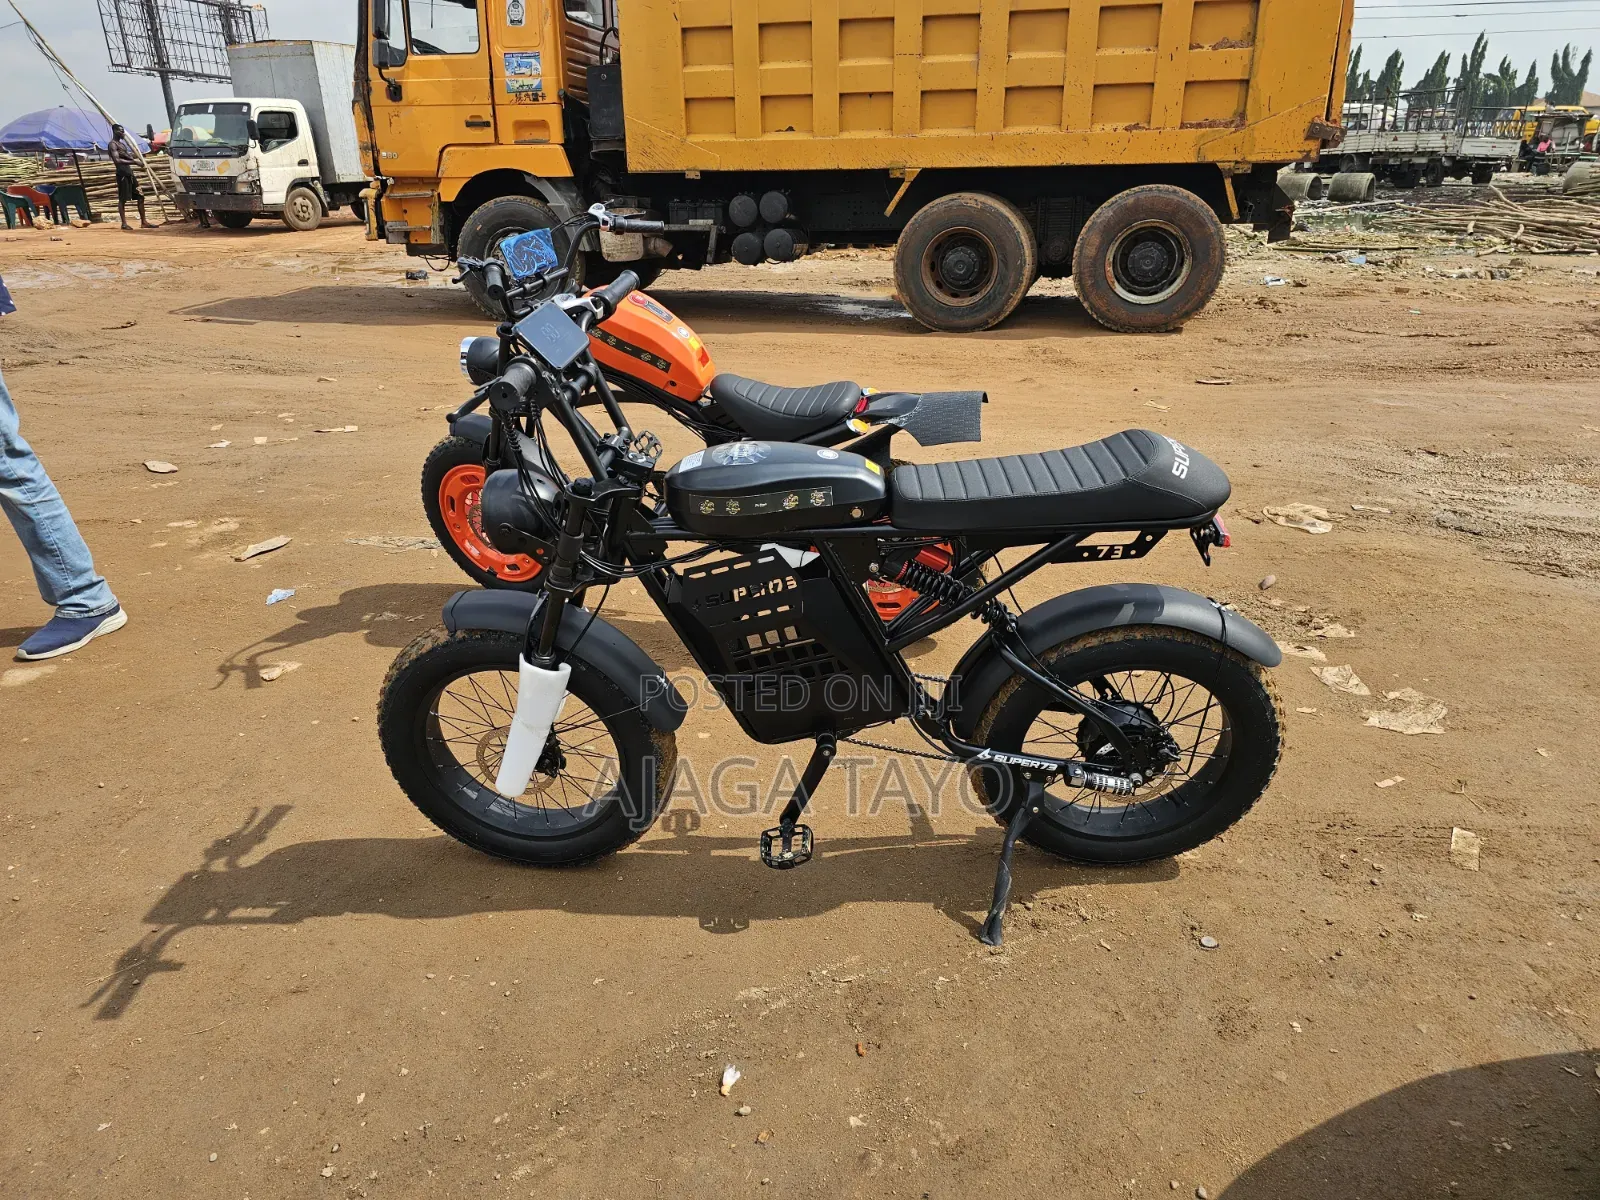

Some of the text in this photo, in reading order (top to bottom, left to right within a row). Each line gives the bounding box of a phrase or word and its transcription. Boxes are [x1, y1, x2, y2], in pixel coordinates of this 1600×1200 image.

[1096, 545, 1123, 559] 73
[705, 575, 798, 609] SUPER73
[993, 754, 1059, 772] SUPER73
